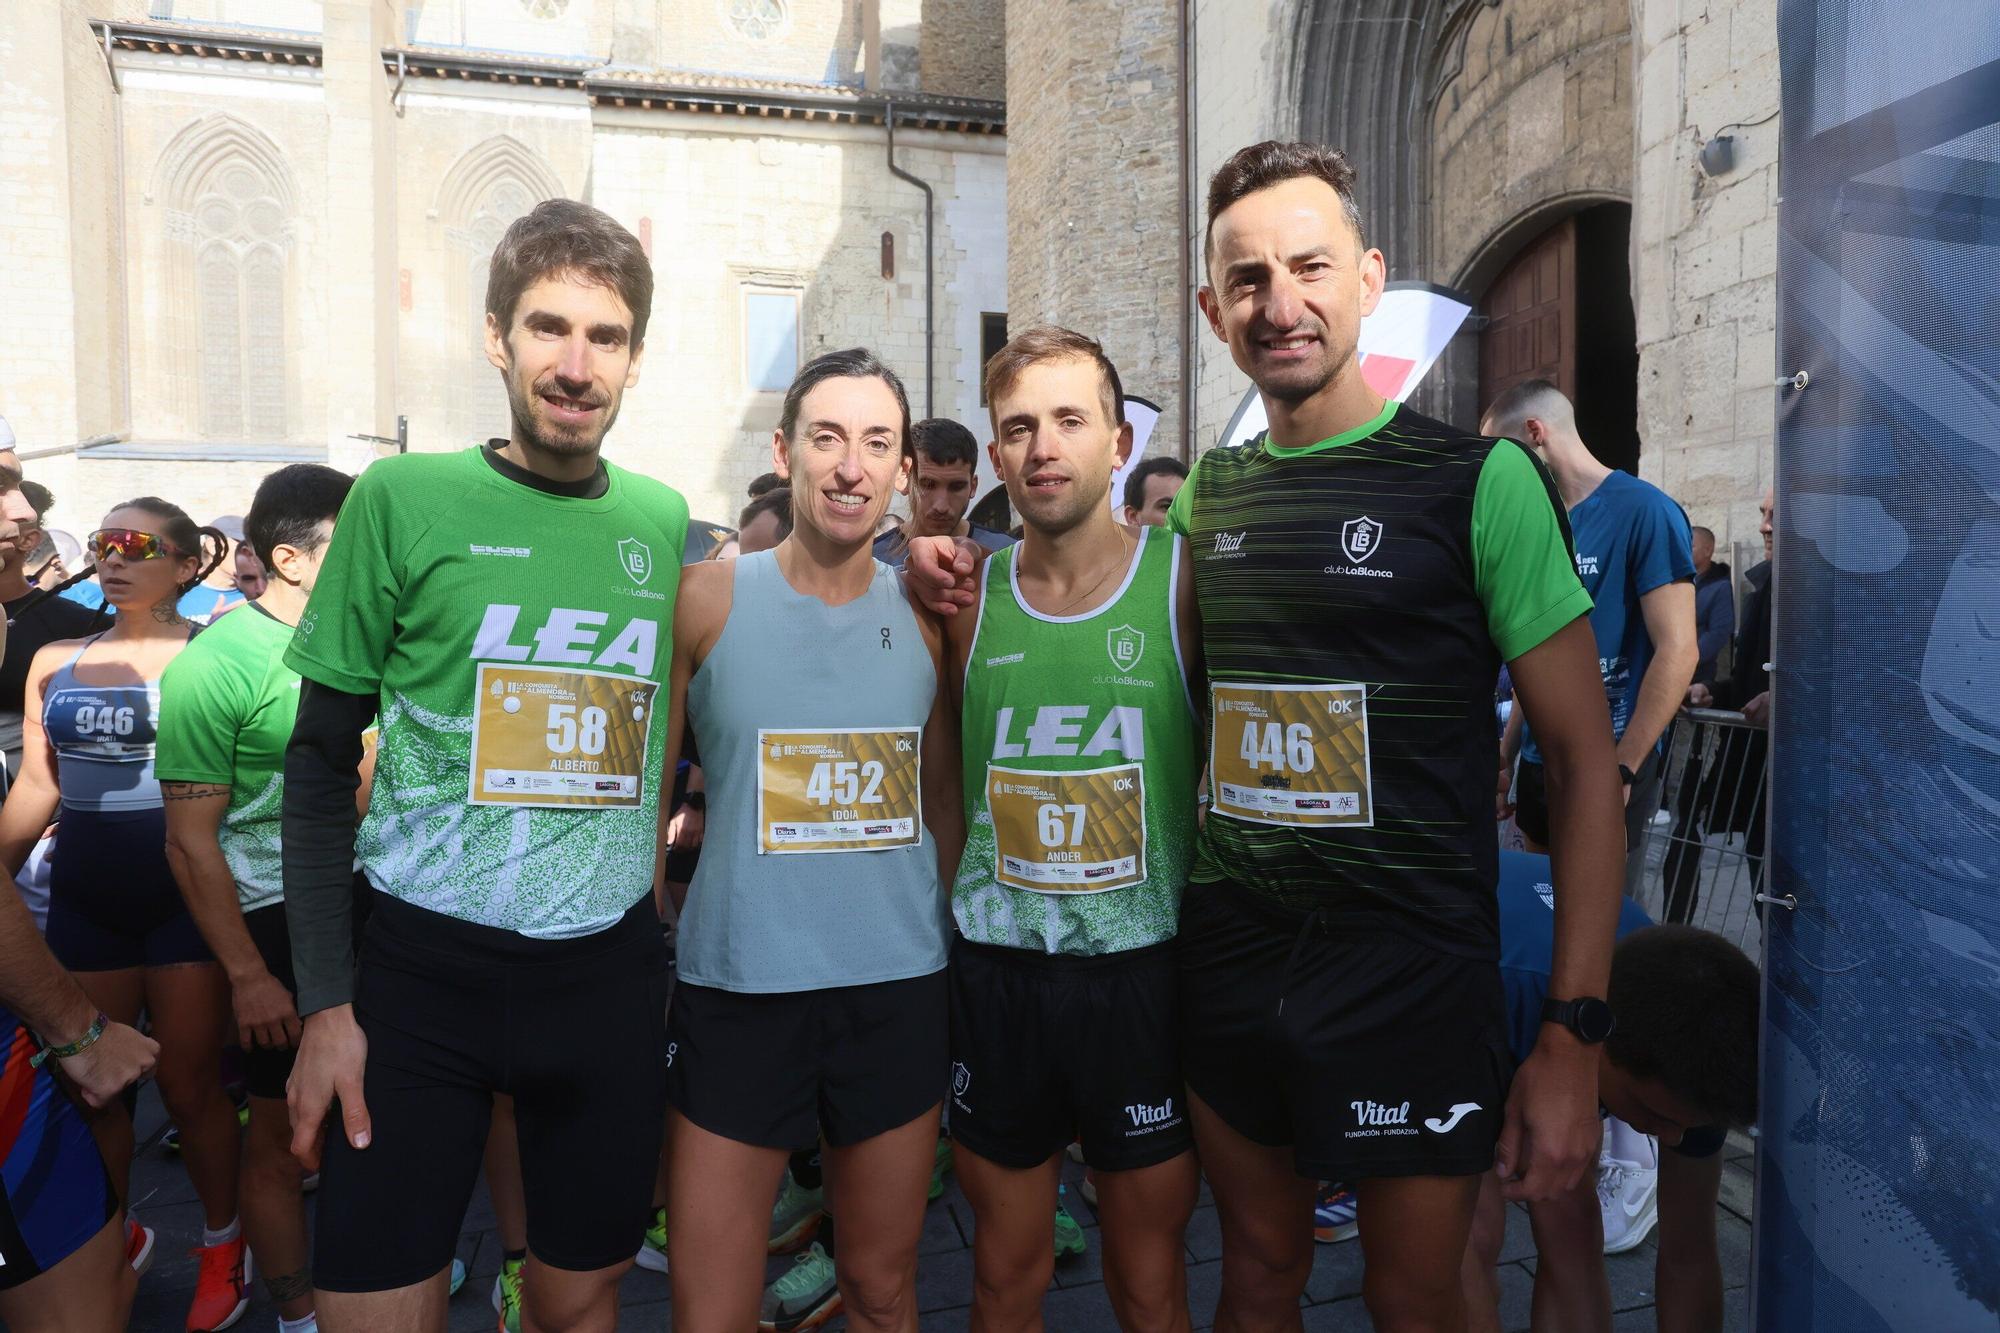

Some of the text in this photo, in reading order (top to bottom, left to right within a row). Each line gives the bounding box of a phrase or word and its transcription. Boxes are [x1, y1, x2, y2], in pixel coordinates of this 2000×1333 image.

[1213, 531, 1247, 553] Vital
[1324, 565, 1393, 578] club LaBlanca
[611, 585, 665, 600] club LaBlanca
[469, 603, 658, 676] LEA
[1092, 674, 1154, 688] club LaBlanca
[630, 690, 646, 703] 10K
[1328, 699, 1352, 714] 10K
[75, 706, 135, 735] 946
[546, 704, 607, 756] 58
[991, 705, 1145, 760] LEA
[896, 739, 913, 752] 10K
[1240, 720, 1315, 774] 446
[549, 759, 600, 772] ALBERTO
[806, 760, 884, 806] 452
[1113, 777, 1133, 792] 10K
[832, 809, 859, 820] IDOIA
[1037, 803, 1086, 847] 67
[1046, 851, 1081, 863] ANDER
[1124, 1097, 1173, 1127] Vital
[1350, 1100, 1410, 1126] Vital
[1345, 1128, 1419, 1138] FUNDACIÓN FUNDAZIOA
